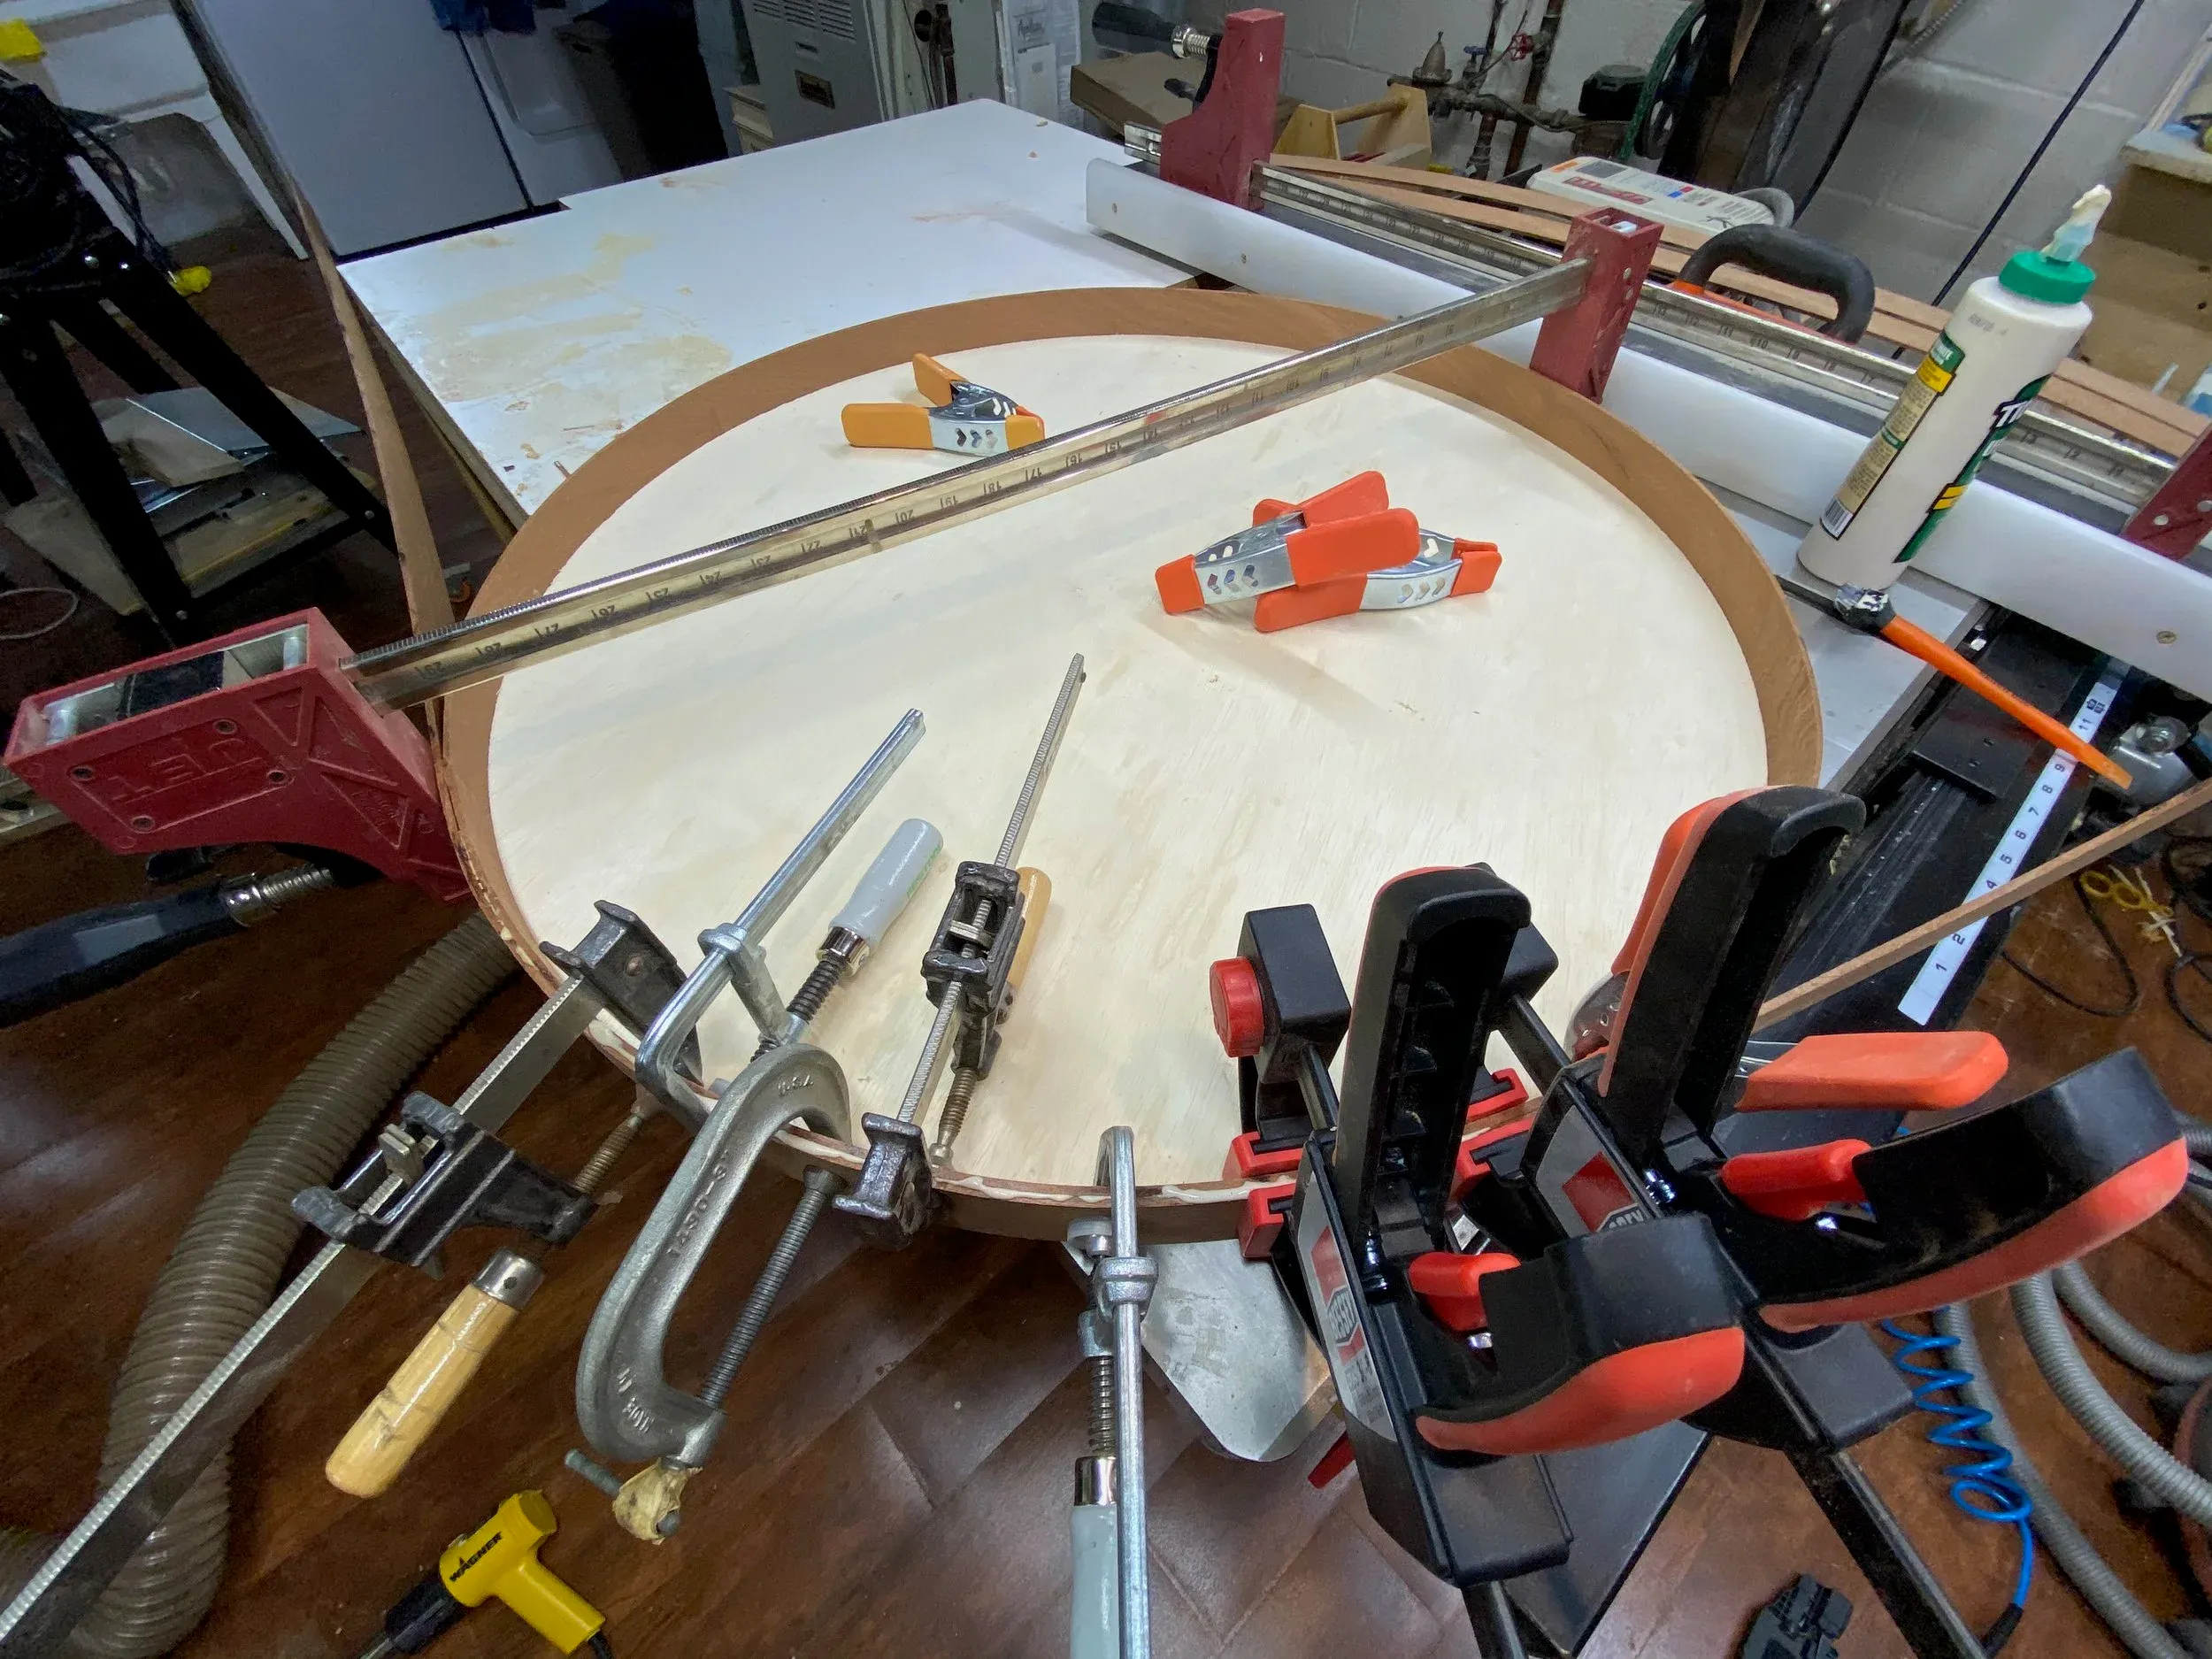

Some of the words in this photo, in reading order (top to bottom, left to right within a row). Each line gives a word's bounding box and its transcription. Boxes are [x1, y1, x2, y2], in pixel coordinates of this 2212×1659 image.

[1936, 961, 1947, 972] 1
[1952, 933, 1965, 946] 2
[2000, 853, 2013, 865] 5
[2015, 829, 2027, 841] 6
[2028, 806, 2039, 817] 7
[2041, 784, 2054, 795] 8
[2054, 763, 2066, 773] 9
[2078, 718, 2093, 731] 11
[449, 1531, 503, 1582] WAGNER
